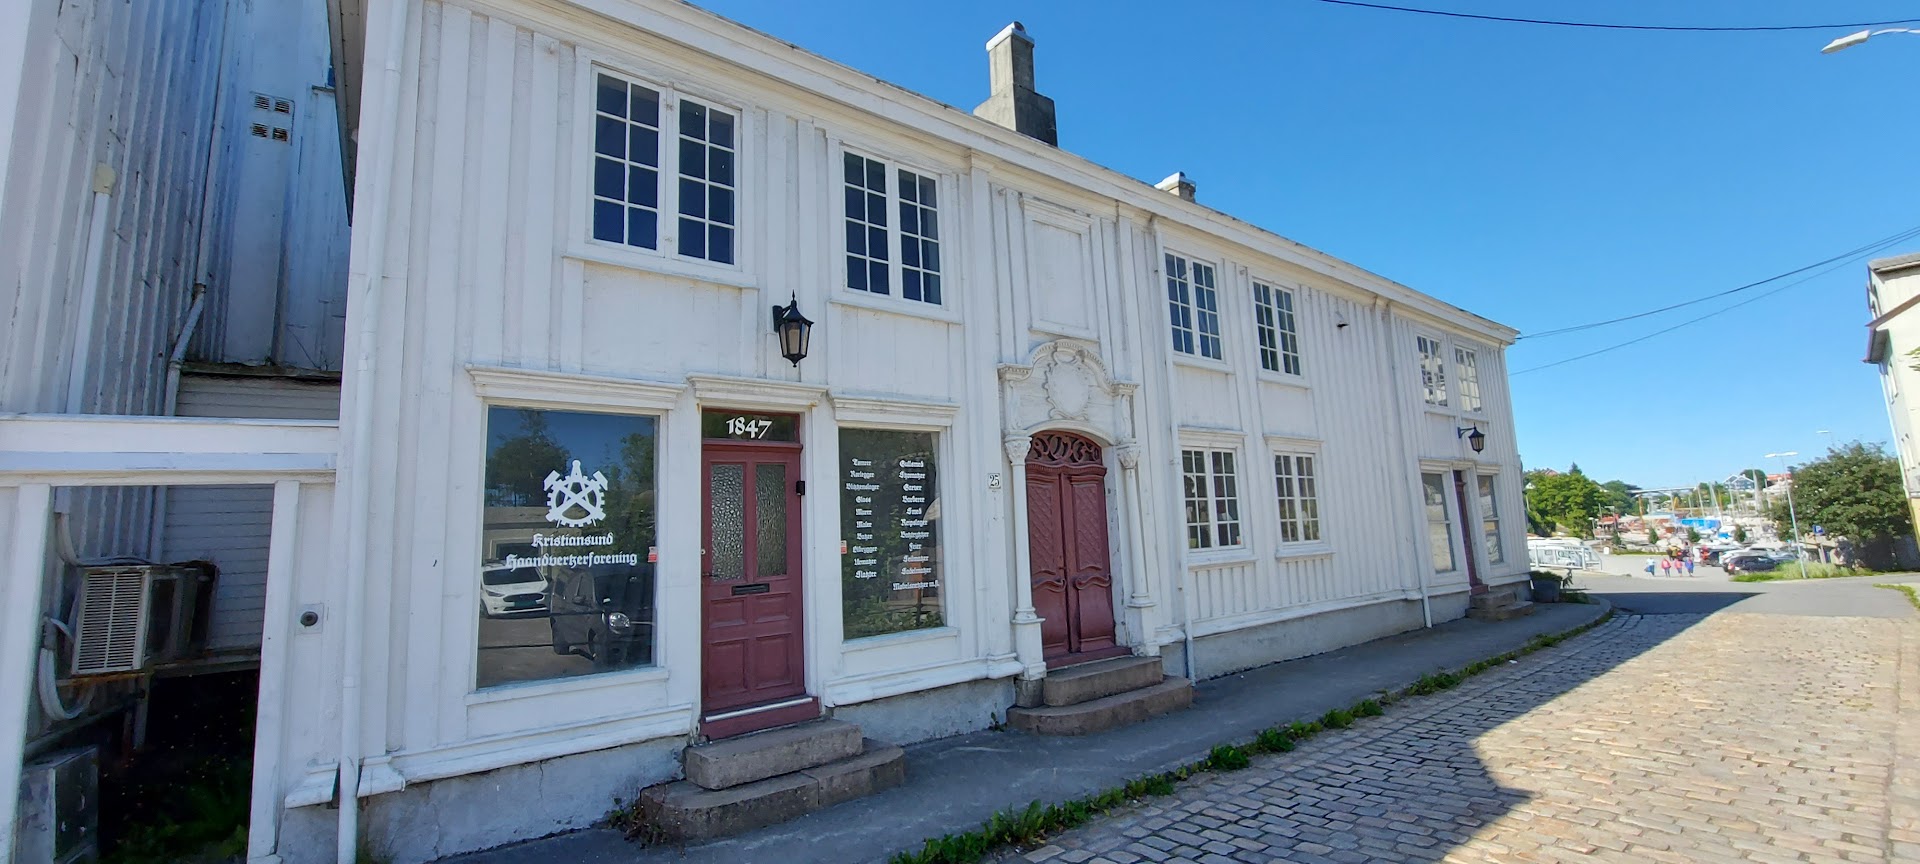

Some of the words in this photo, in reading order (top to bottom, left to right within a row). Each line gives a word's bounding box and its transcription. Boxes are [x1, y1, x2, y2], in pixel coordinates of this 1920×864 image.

[726, 417, 772, 439] 1847
[989, 474, 1000, 487] 25
[530, 532, 614, 548] Kristiansund
